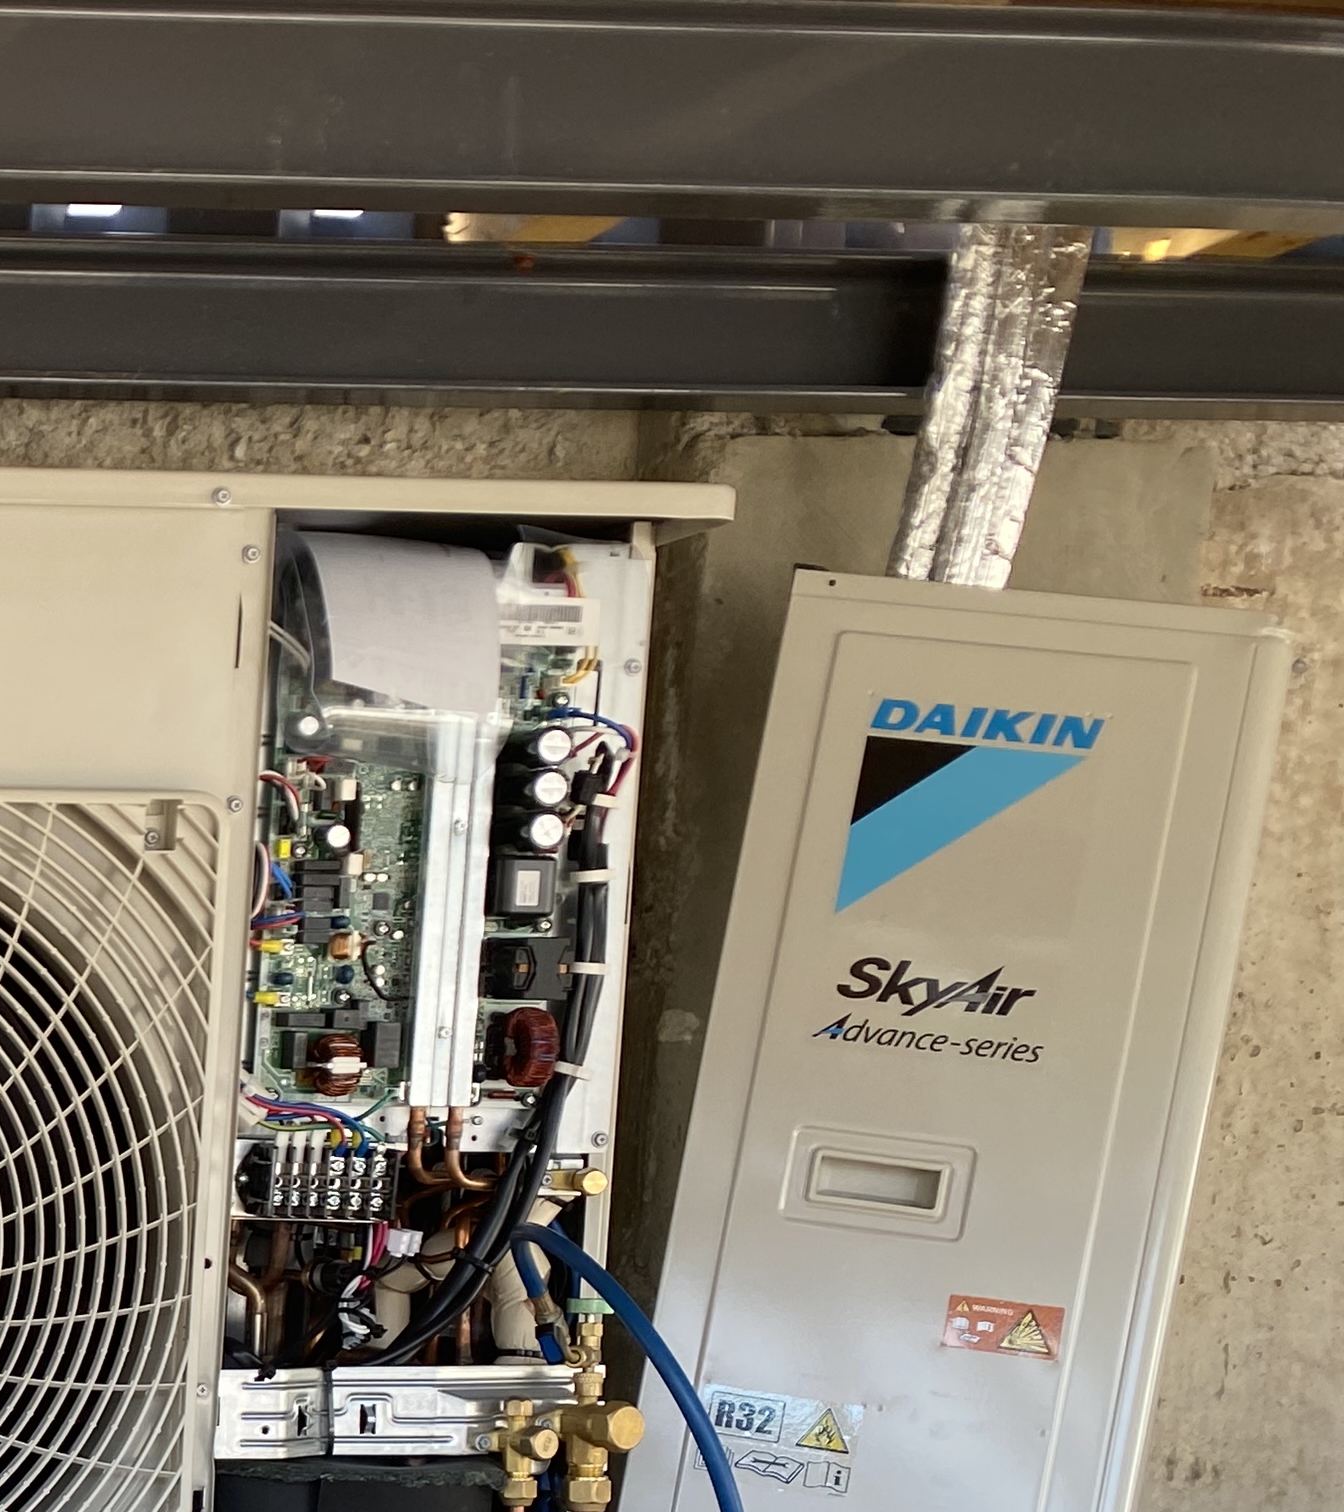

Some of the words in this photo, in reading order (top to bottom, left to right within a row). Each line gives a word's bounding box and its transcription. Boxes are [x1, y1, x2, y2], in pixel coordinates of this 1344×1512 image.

[870, 697, 1105, 750] DAIKIN
[811, 1011, 1045, 1064] Advance-series
[715, 1398, 777, 1435] R32
